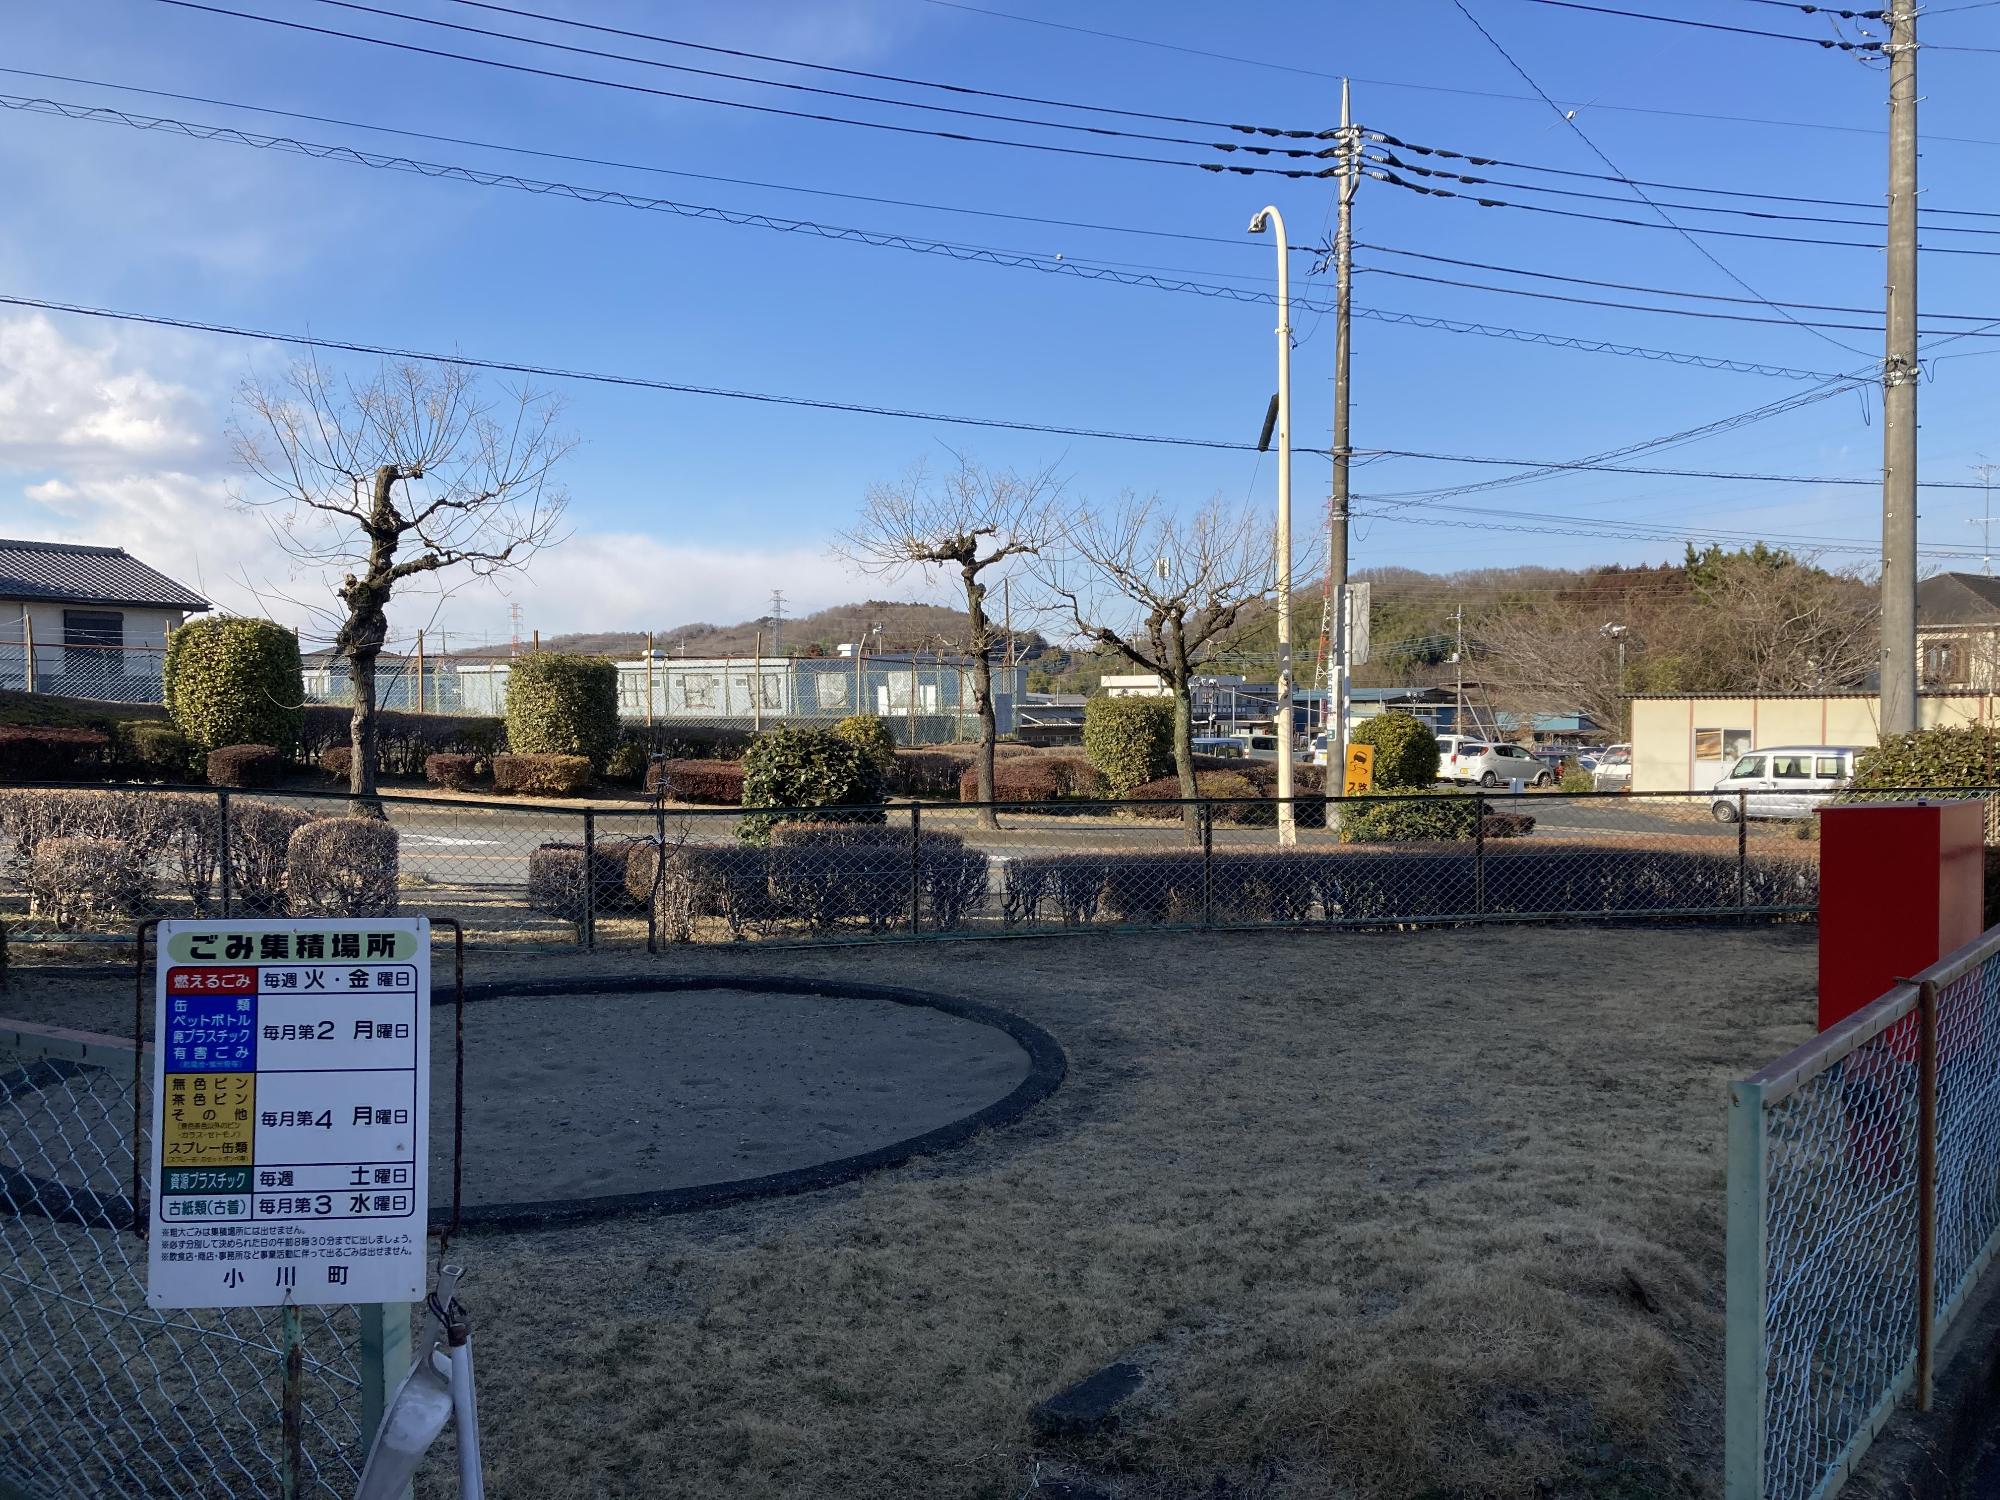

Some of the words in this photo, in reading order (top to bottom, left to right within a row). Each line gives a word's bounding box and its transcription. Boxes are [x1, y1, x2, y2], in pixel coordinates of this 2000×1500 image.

[190, 933, 396, 960] ごみ集積場所
[174, 974, 251, 989] 燃えるごみ
[173, 1013, 251, 1027] ペットボトル
[168, 1141, 248, 1155] スプレー缶類
[170, 1171, 246, 1190] 資源プラスチック
